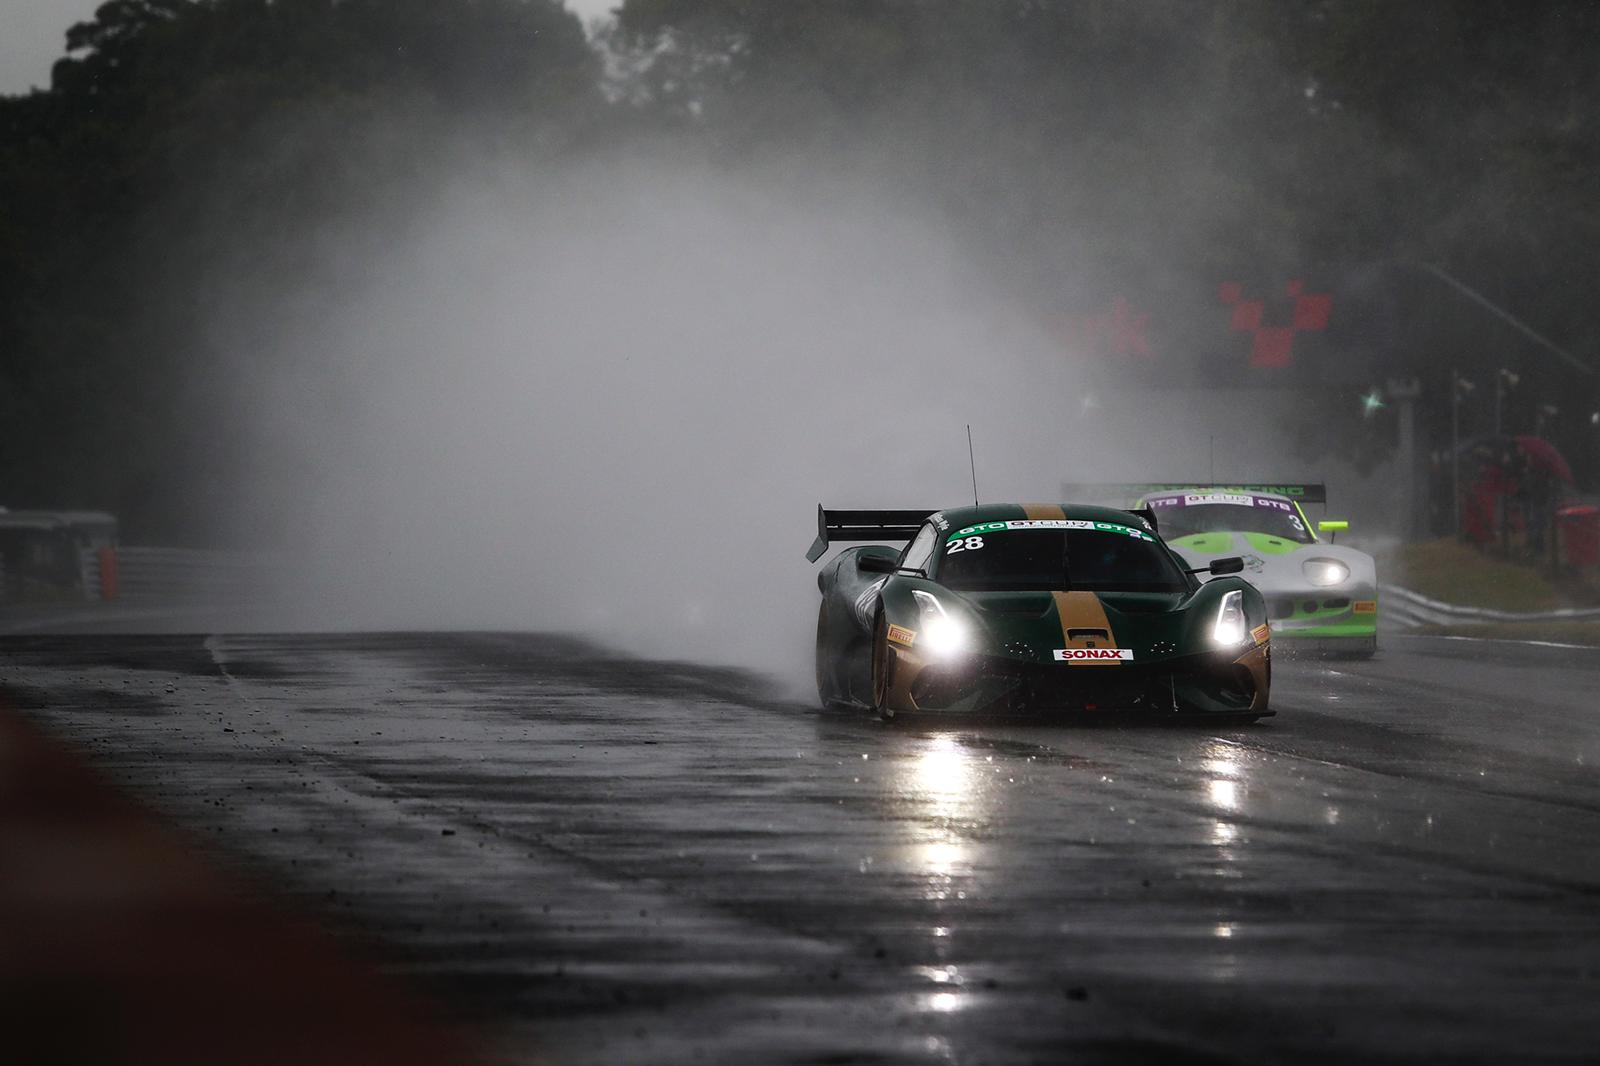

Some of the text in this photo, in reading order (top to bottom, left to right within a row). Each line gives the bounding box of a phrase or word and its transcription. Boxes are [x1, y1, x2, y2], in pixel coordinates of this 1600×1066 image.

[1258, 500, 1291, 512] GTB
[1288, 514, 1305, 531] 3
[959, 523, 1005, 535] GTO
[1096, 523, 1142, 535] GTO
[946, 536, 984, 555] 28
[1061, 650, 1122, 659] SONAX
